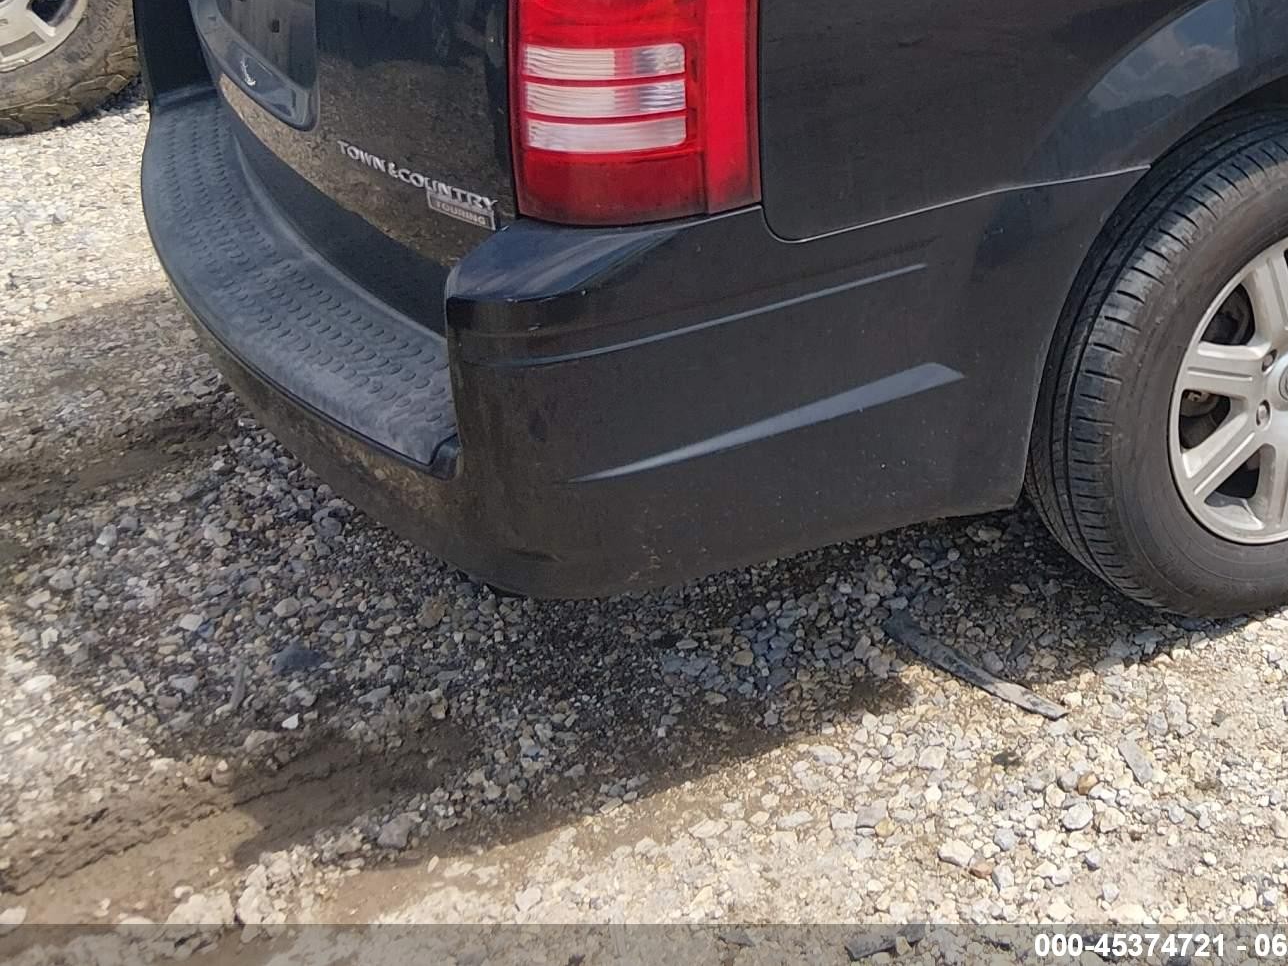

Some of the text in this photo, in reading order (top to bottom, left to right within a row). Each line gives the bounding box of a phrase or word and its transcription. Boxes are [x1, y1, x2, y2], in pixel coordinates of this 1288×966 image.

[337, 140, 386, 173] TOWN
[398, 167, 498, 211] COUNTRY
[434, 200, 487, 226] TOURING
